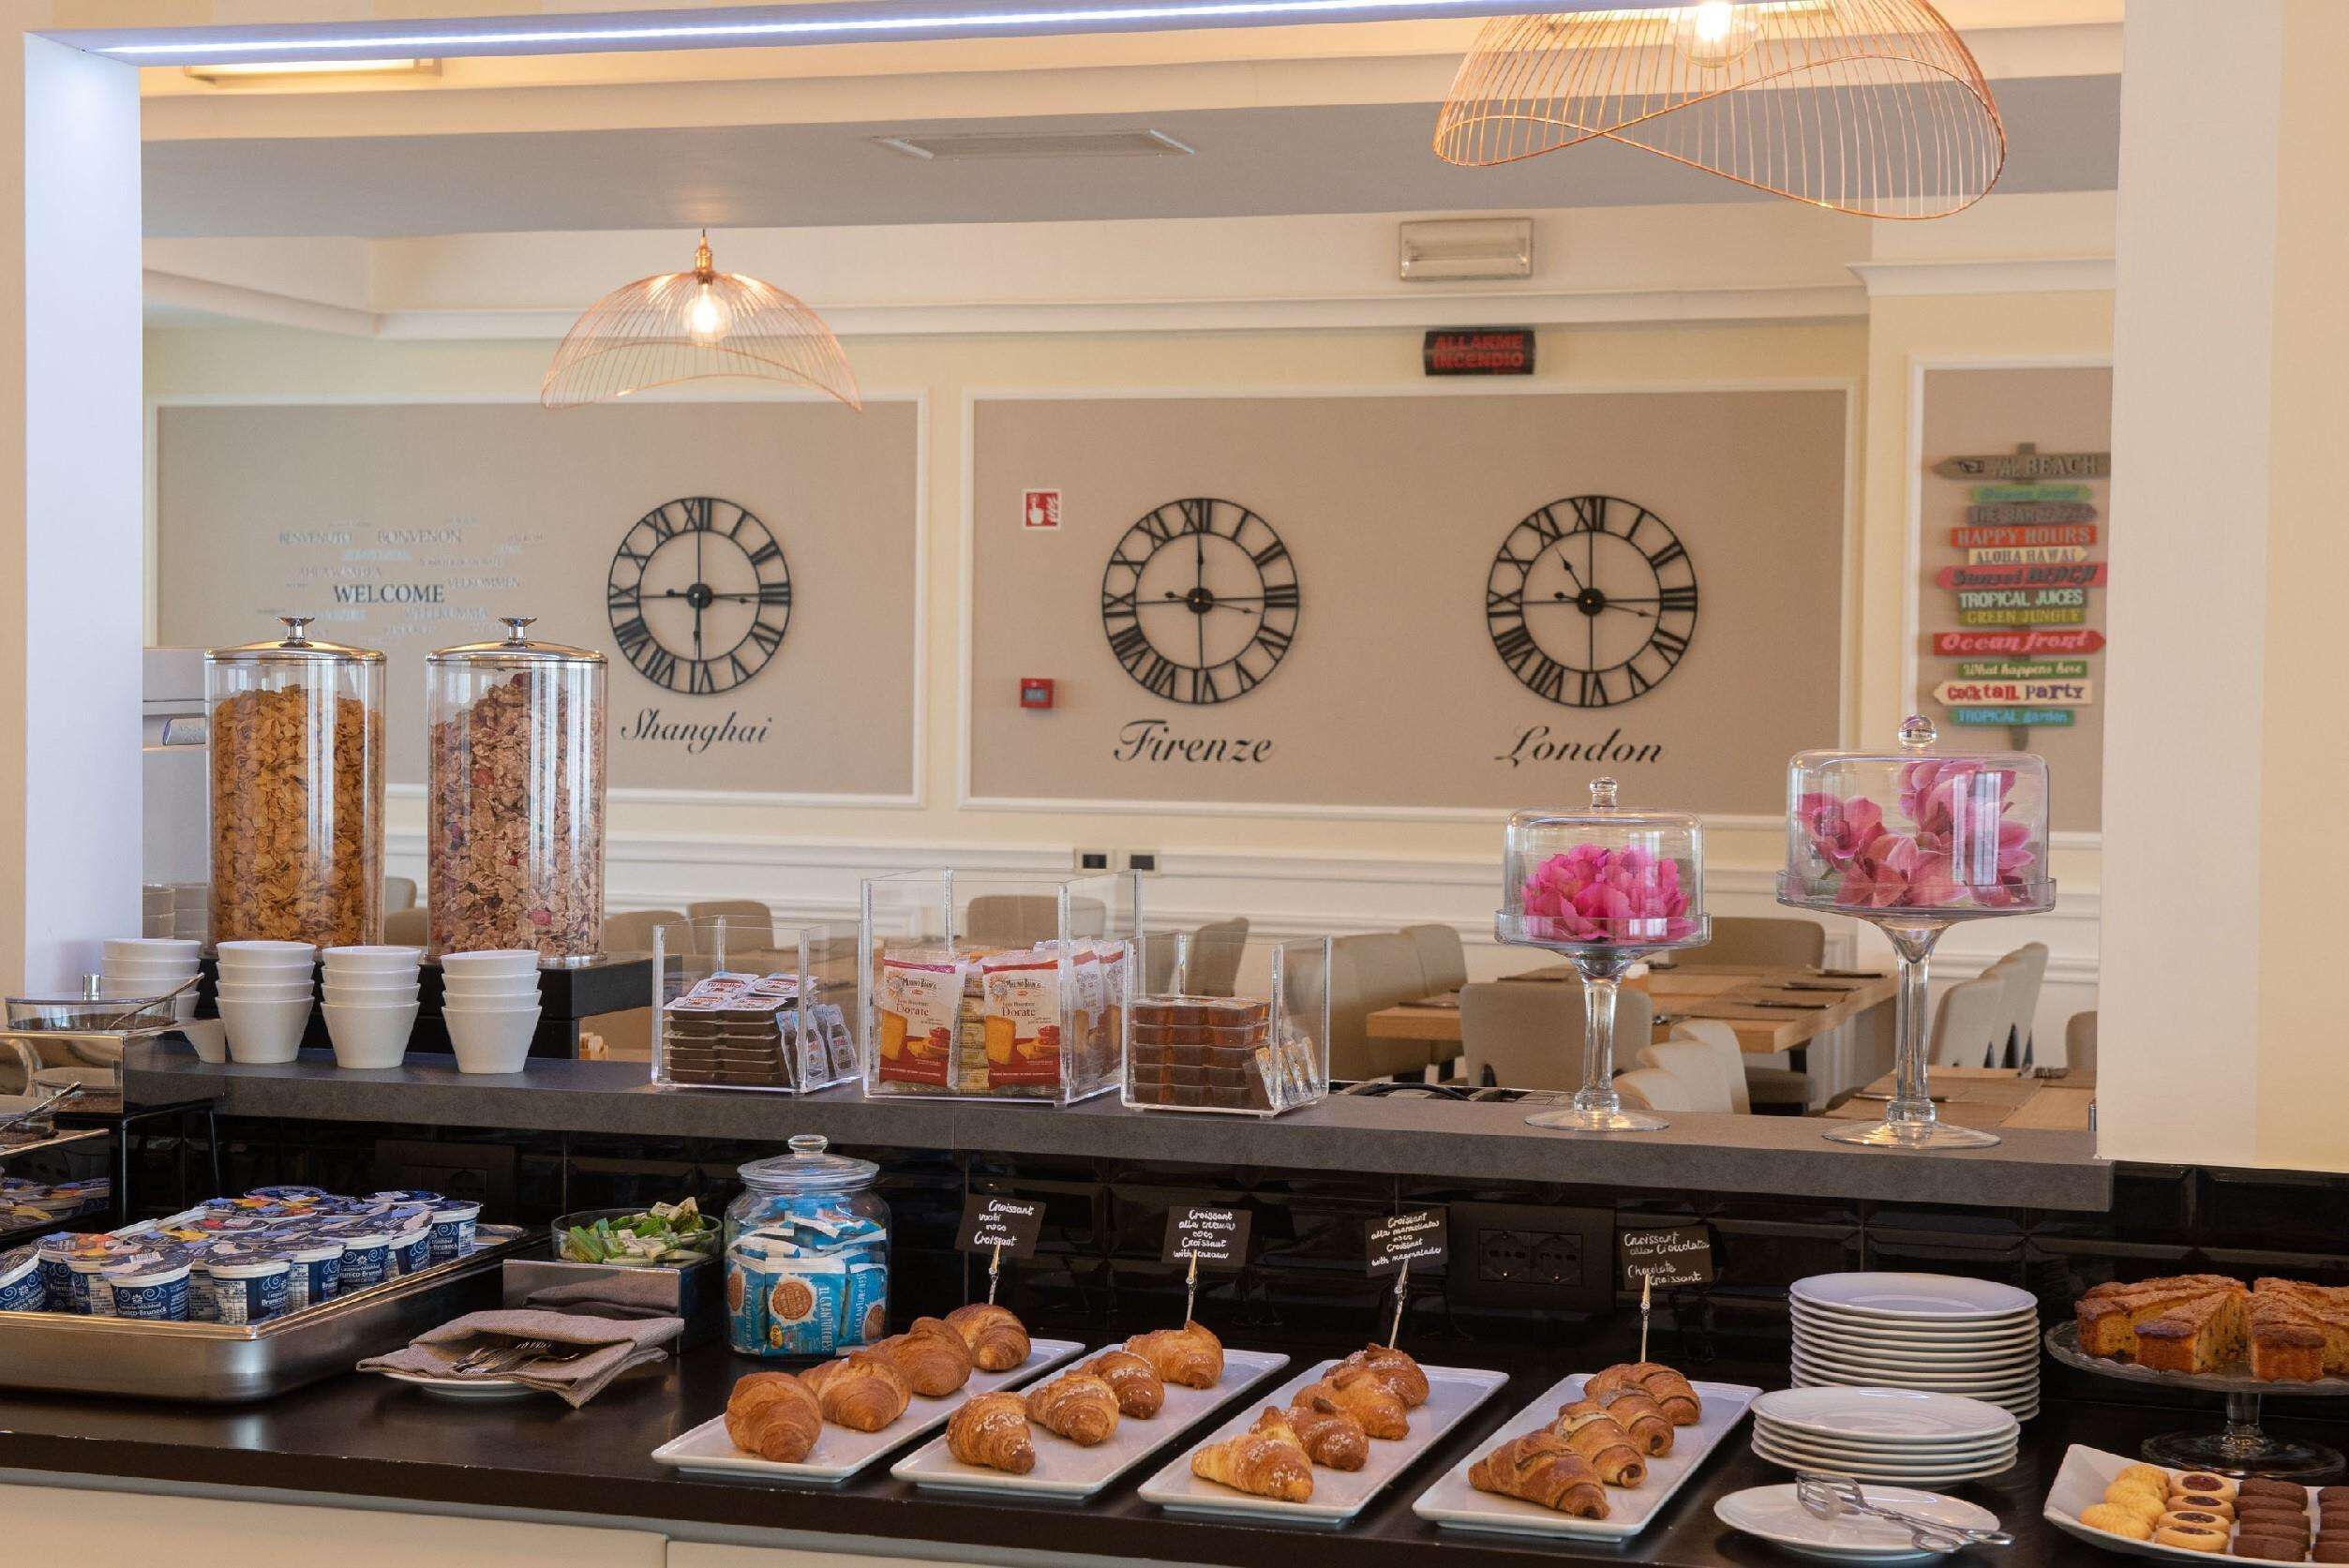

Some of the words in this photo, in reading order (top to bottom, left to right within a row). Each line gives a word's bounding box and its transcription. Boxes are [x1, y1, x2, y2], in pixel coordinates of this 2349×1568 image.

[1434, 334, 1523, 349] ALLARME
[1433, 351, 1524, 367] INCENDIO
[642, 507, 674, 544] XI
[681, 498, 712, 530] XII
[728, 512, 748, 539] I
[1179, 500, 1213, 534] XII
[1231, 511, 1250, 540] I
[1571, 497, 1606, 532] XII
[1627, 510, 1646, 540] I
[1134, 511, 1170, 550] XI
[1522, 508, 1562, 548] XI
[1956, 528, 2019, 545] HAPPY
[2025, 526, 2090, 544] HOURS
[618, 542, 649, 571] X
[750, 541, 781, 565] II
[1110, 548, 1144, 576] X
[1253, 540, 1286, 567] II
[1497, 545, 1534, 575] X
[1650, 541, 1684, 568] II
[1976, 549, 2021, 563] ALOHA
[333, 583, 446, 604] WELCOME
[608, 583, 641, 608] IX
[760, 583, 790, 605] III
[1102, 591, 1136, 618] IX
[1264, 584, 1298, 607] III
[1487, 589, 1522, 617] IX
[1661, 587, 1698, 611] III
[1959, 591, 2030, 608] TROPICAL
[2035, 589, 2084, 605] JUICES
[1967, 611, 2015, 624] GREEN
[2023, 610, 2080, 623] JUNGLE
[1940, 634, 2020, 650] Ocean
[2022, 631, 2088, 652] front
[643, 646, 675, 688] VII
[690, 660, 714, 693] VI
[729, 653, 750, 684] V
[1142, 654, 1175, 699] VII
[1234, 658, 1257, 693] V
[1528, 657, 1564, 701] VII
[1626, 662, 1651, 696] V
[1963, 664, 1998, 676] What
[2001, 663, 2053, 678] happens
[2056, 663, 2083, 674] here
[1193, 669, 1219, 702] VI
[1580, 672, 1608, 705] VI
[1958, 709, 2015, 724] TROPICAL
[621, 708, 772, 754] Shanghai
[1114, 718, 1272, 763] Firenze
[1494, 725, 1663, 768] London
[896, 1003, 930, 1017] Dorate
[1002, 1007, 1036, 1017] Dorate
[988, 1200, 1035, 1216] Croissant
[1189, 1209, 1233, 1221] Croissant
[974, 1231, 1018, 1247] Croissant
[1182, 1237, 1227, 1248] Croissant
[1623, 1232, 1680, 1247] Croissant
[1629, 1246, 1653, 1255] alla
[1627, 1260, 1677, 1278] Chocolate
[1649, 1271, 1702, 1286] Croissant
